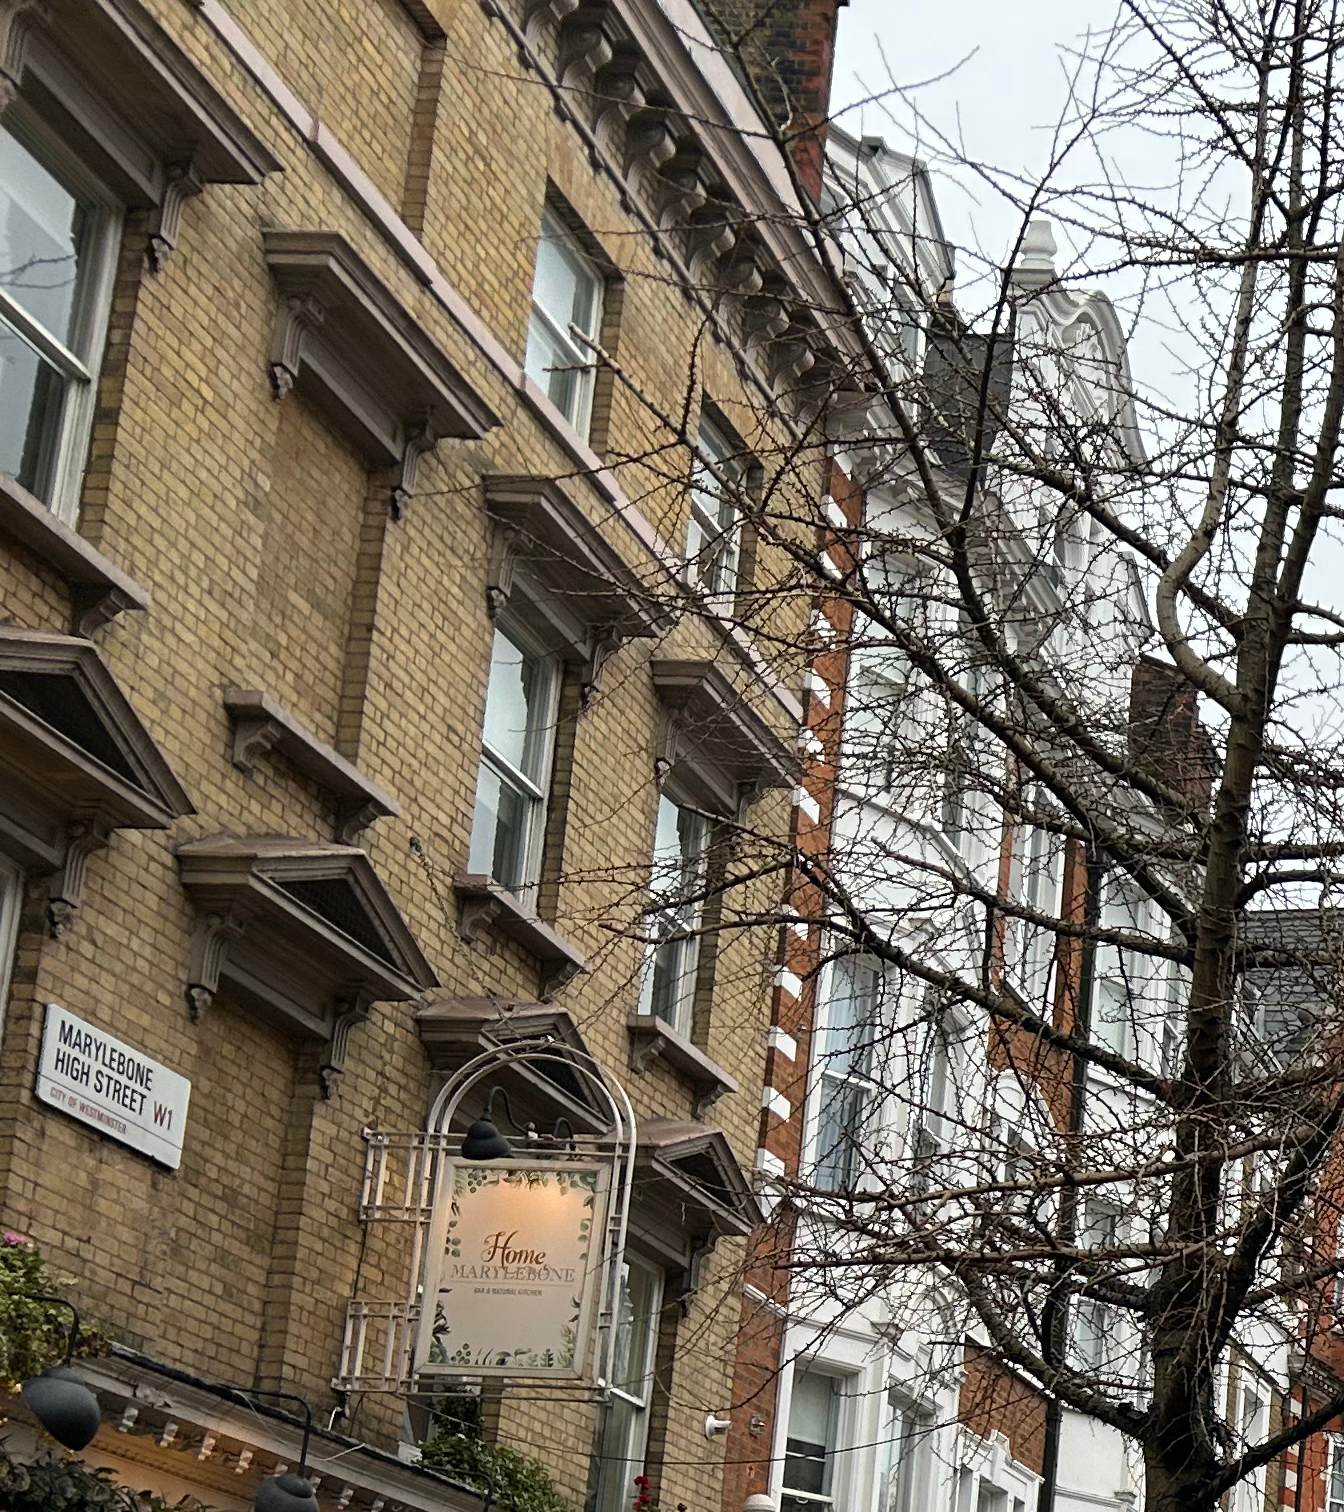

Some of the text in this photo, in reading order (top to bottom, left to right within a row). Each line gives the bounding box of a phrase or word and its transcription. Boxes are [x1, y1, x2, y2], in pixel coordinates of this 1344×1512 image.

[58, 1019, 154, 1092] MARYLEBONE
[54, 1048, 173, 1131] HIGH STREET W1
[450, 1264, 576, 1282] MARYLEBONE
[480, 1230, 547, 1271] Home
